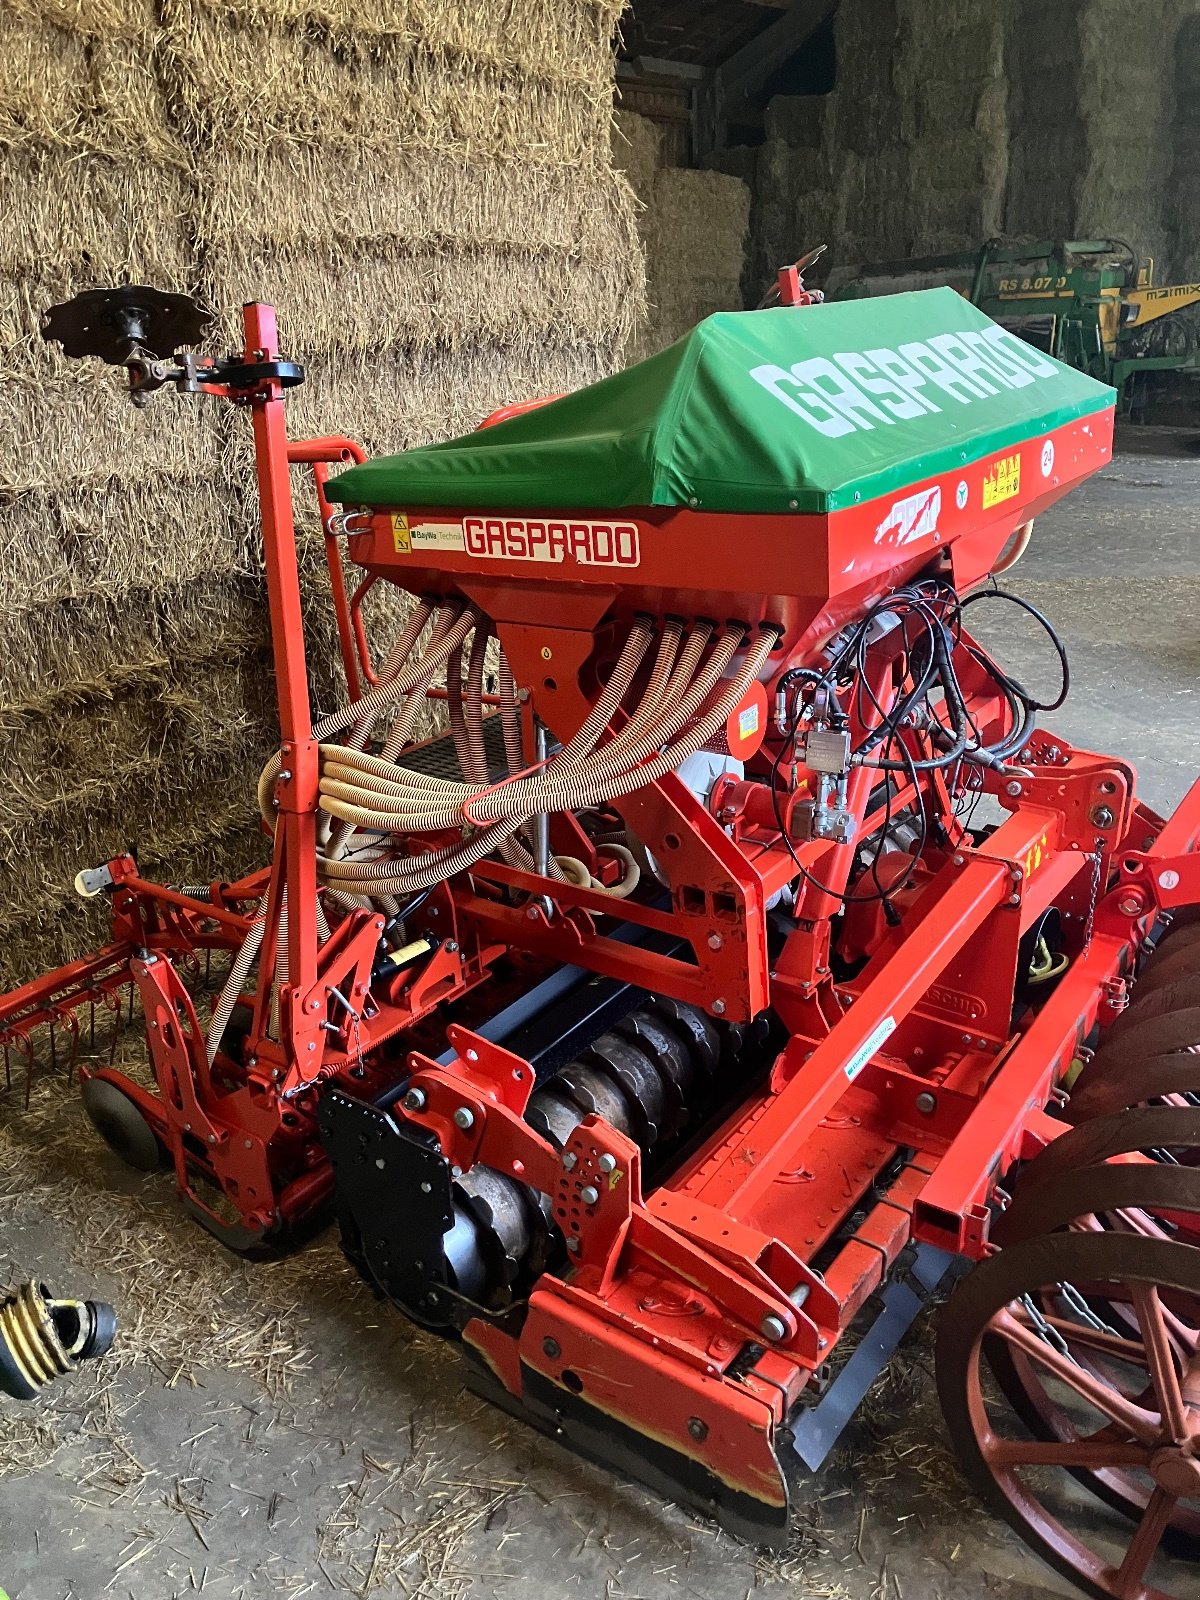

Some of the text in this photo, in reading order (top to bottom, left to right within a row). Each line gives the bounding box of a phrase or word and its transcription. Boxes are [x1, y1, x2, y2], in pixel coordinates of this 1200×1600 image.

[999, 280, 1019, 291] RS
[1022, 277, 1053, 290] 8.07
[749, 325, 1060, 438] GASPARDO
[1043, 449, 1052, 467] 24
[416, 530, 463, 540] BayWa Technik
[465, 519, 637, 564] GASPARDO
